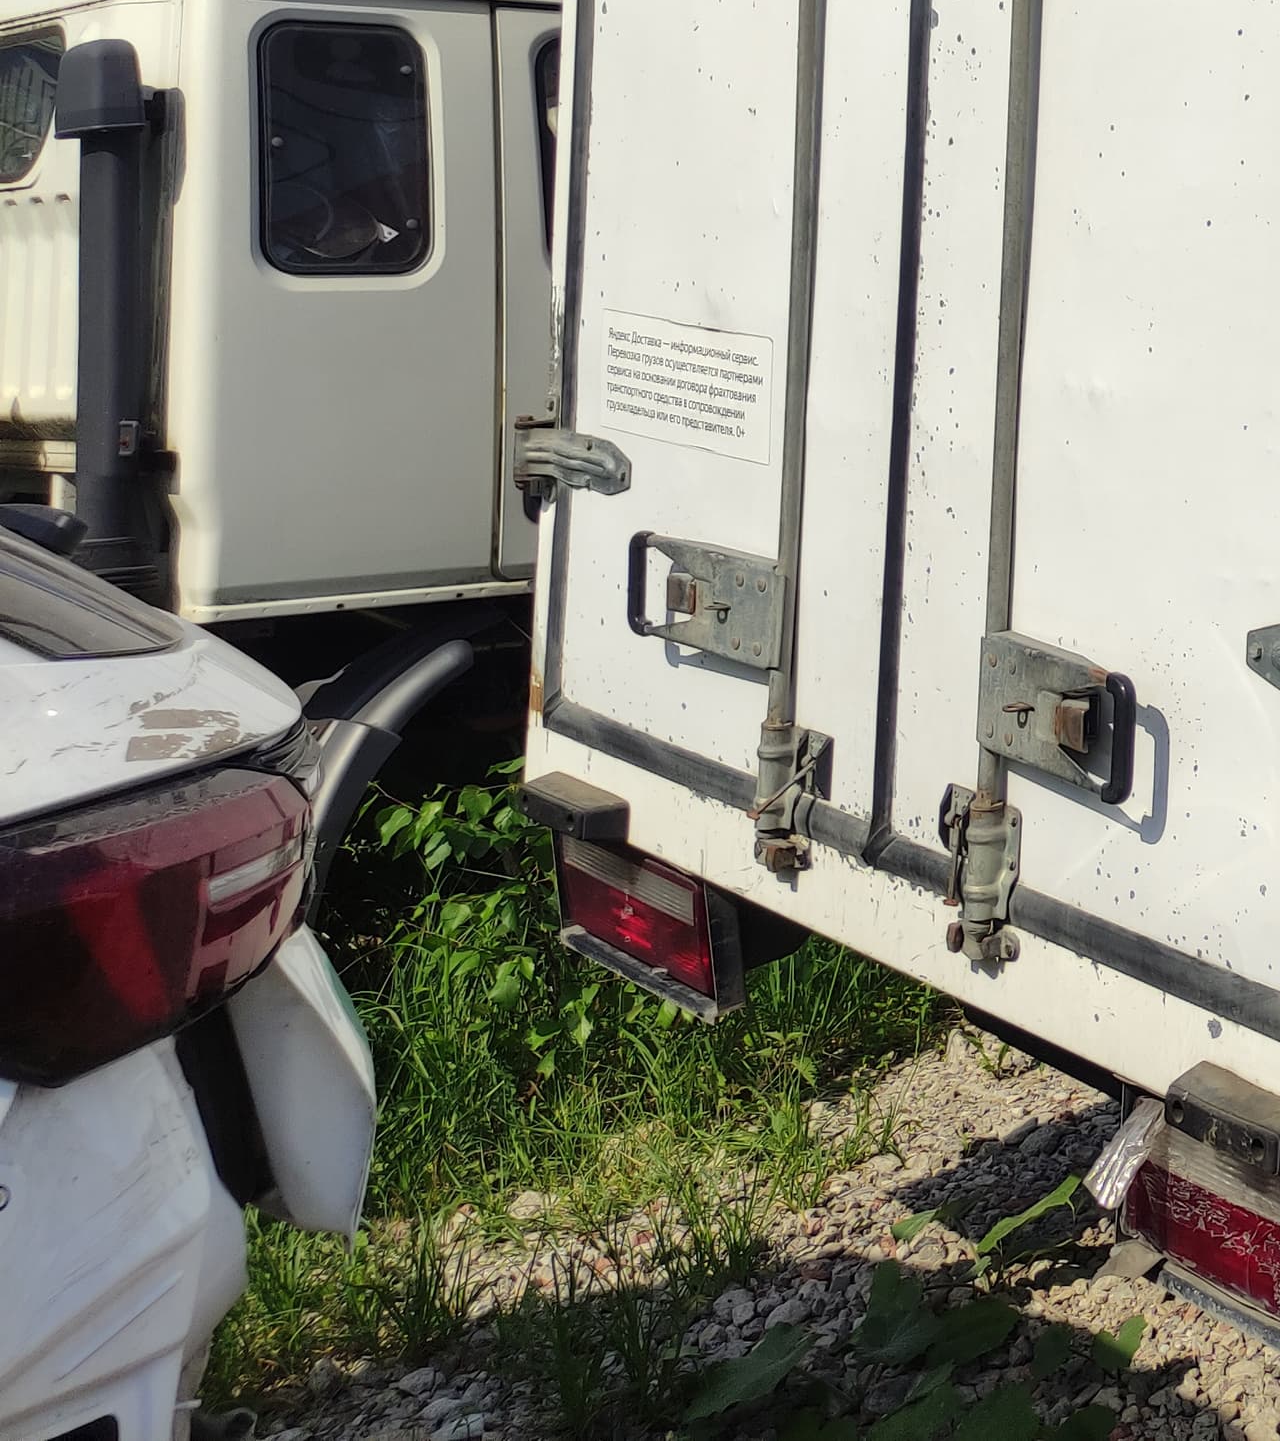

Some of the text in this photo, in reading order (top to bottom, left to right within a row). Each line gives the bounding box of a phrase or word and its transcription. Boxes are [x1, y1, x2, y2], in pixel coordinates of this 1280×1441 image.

[608, 327, 631, 343] Яндекс
[632, 331, 662, 349] Доставка
[670, 338, 731, 360] информационный
[642, 353, 664, 368] грузов
[665, 359, 719, 377] осуществляется
[633, 370, 641, 380] на
[641, 371, 676, 387] основании
[677, 379, 707, 396] договора
[708, 384, 757, 404] фрахтования
[656, 411, 668, 423] или
[669, 413, 681, 425] его
[688, 399, 745, 420] сопровождении
